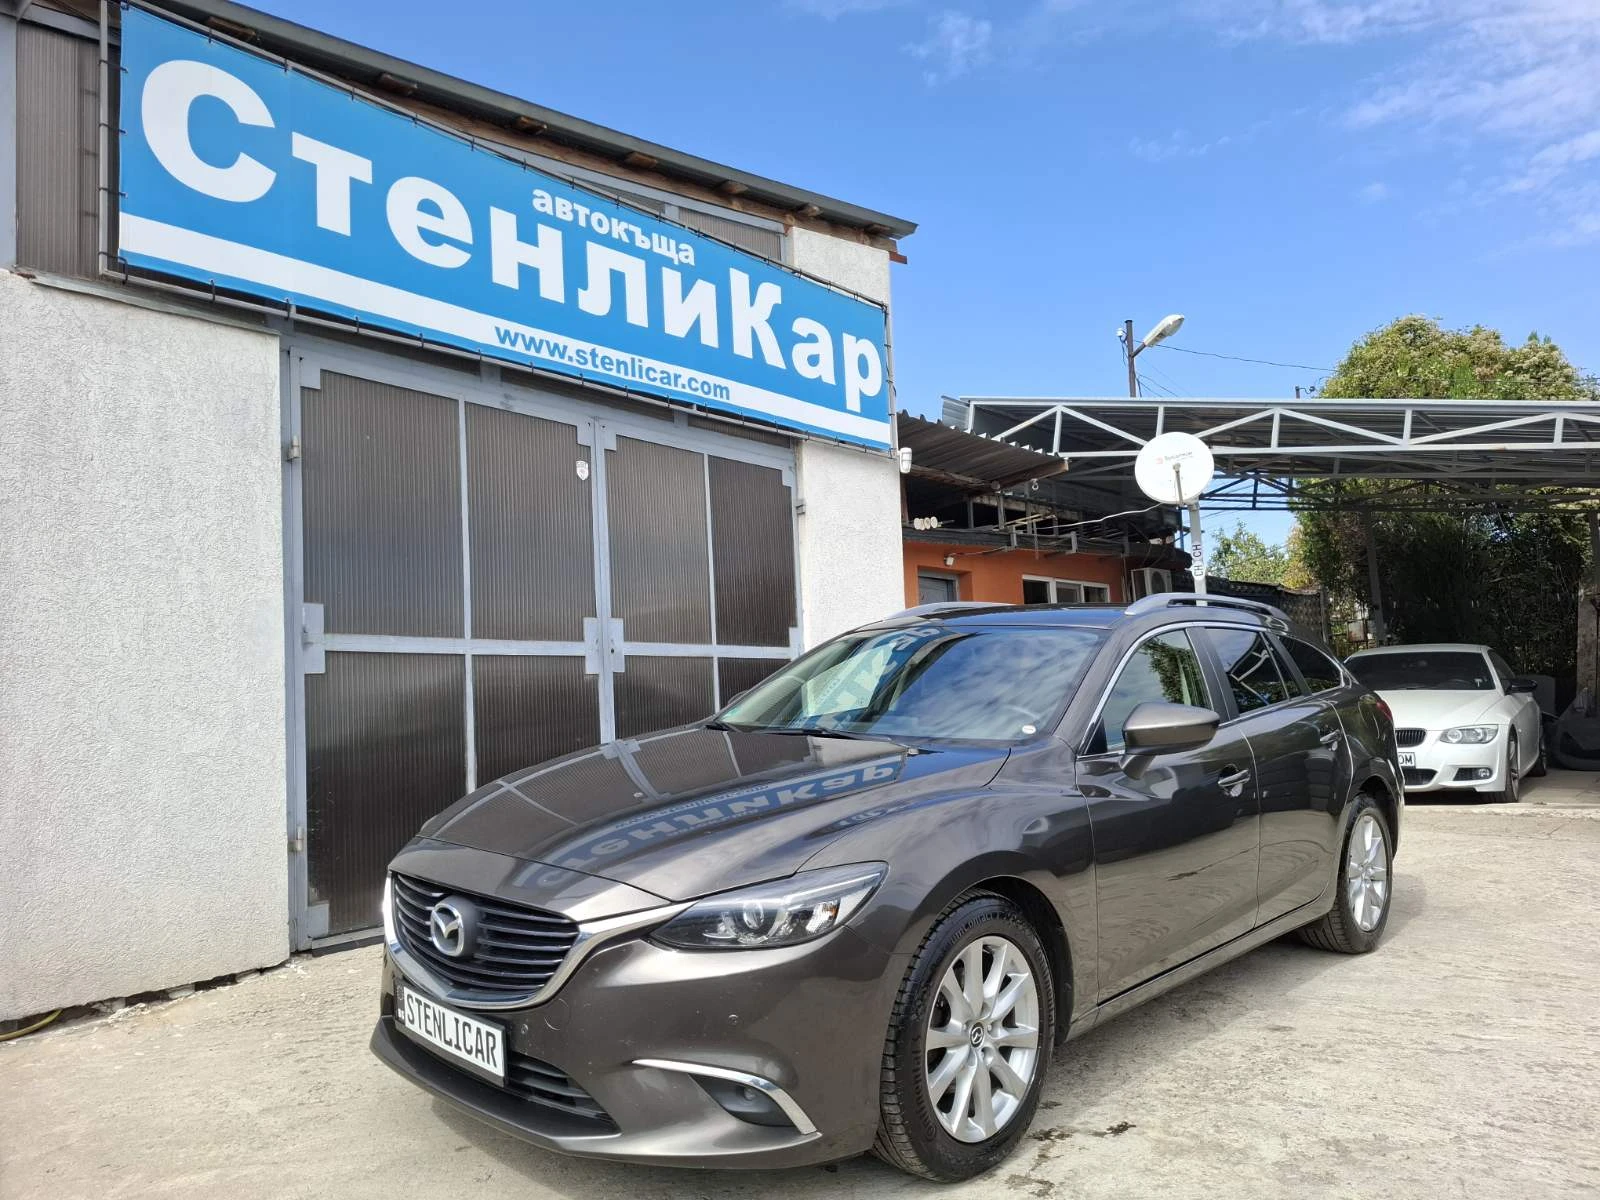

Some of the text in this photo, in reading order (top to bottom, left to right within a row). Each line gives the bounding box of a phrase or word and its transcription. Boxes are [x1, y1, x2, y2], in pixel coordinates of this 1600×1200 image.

[141, 59, 882, 410] СтенлиКар
[532, 187, 695, 267] автокъща
[495, 325, 731, 401] www.stenlicar.com
[406, 993, 498, 1068] STENLICAR
